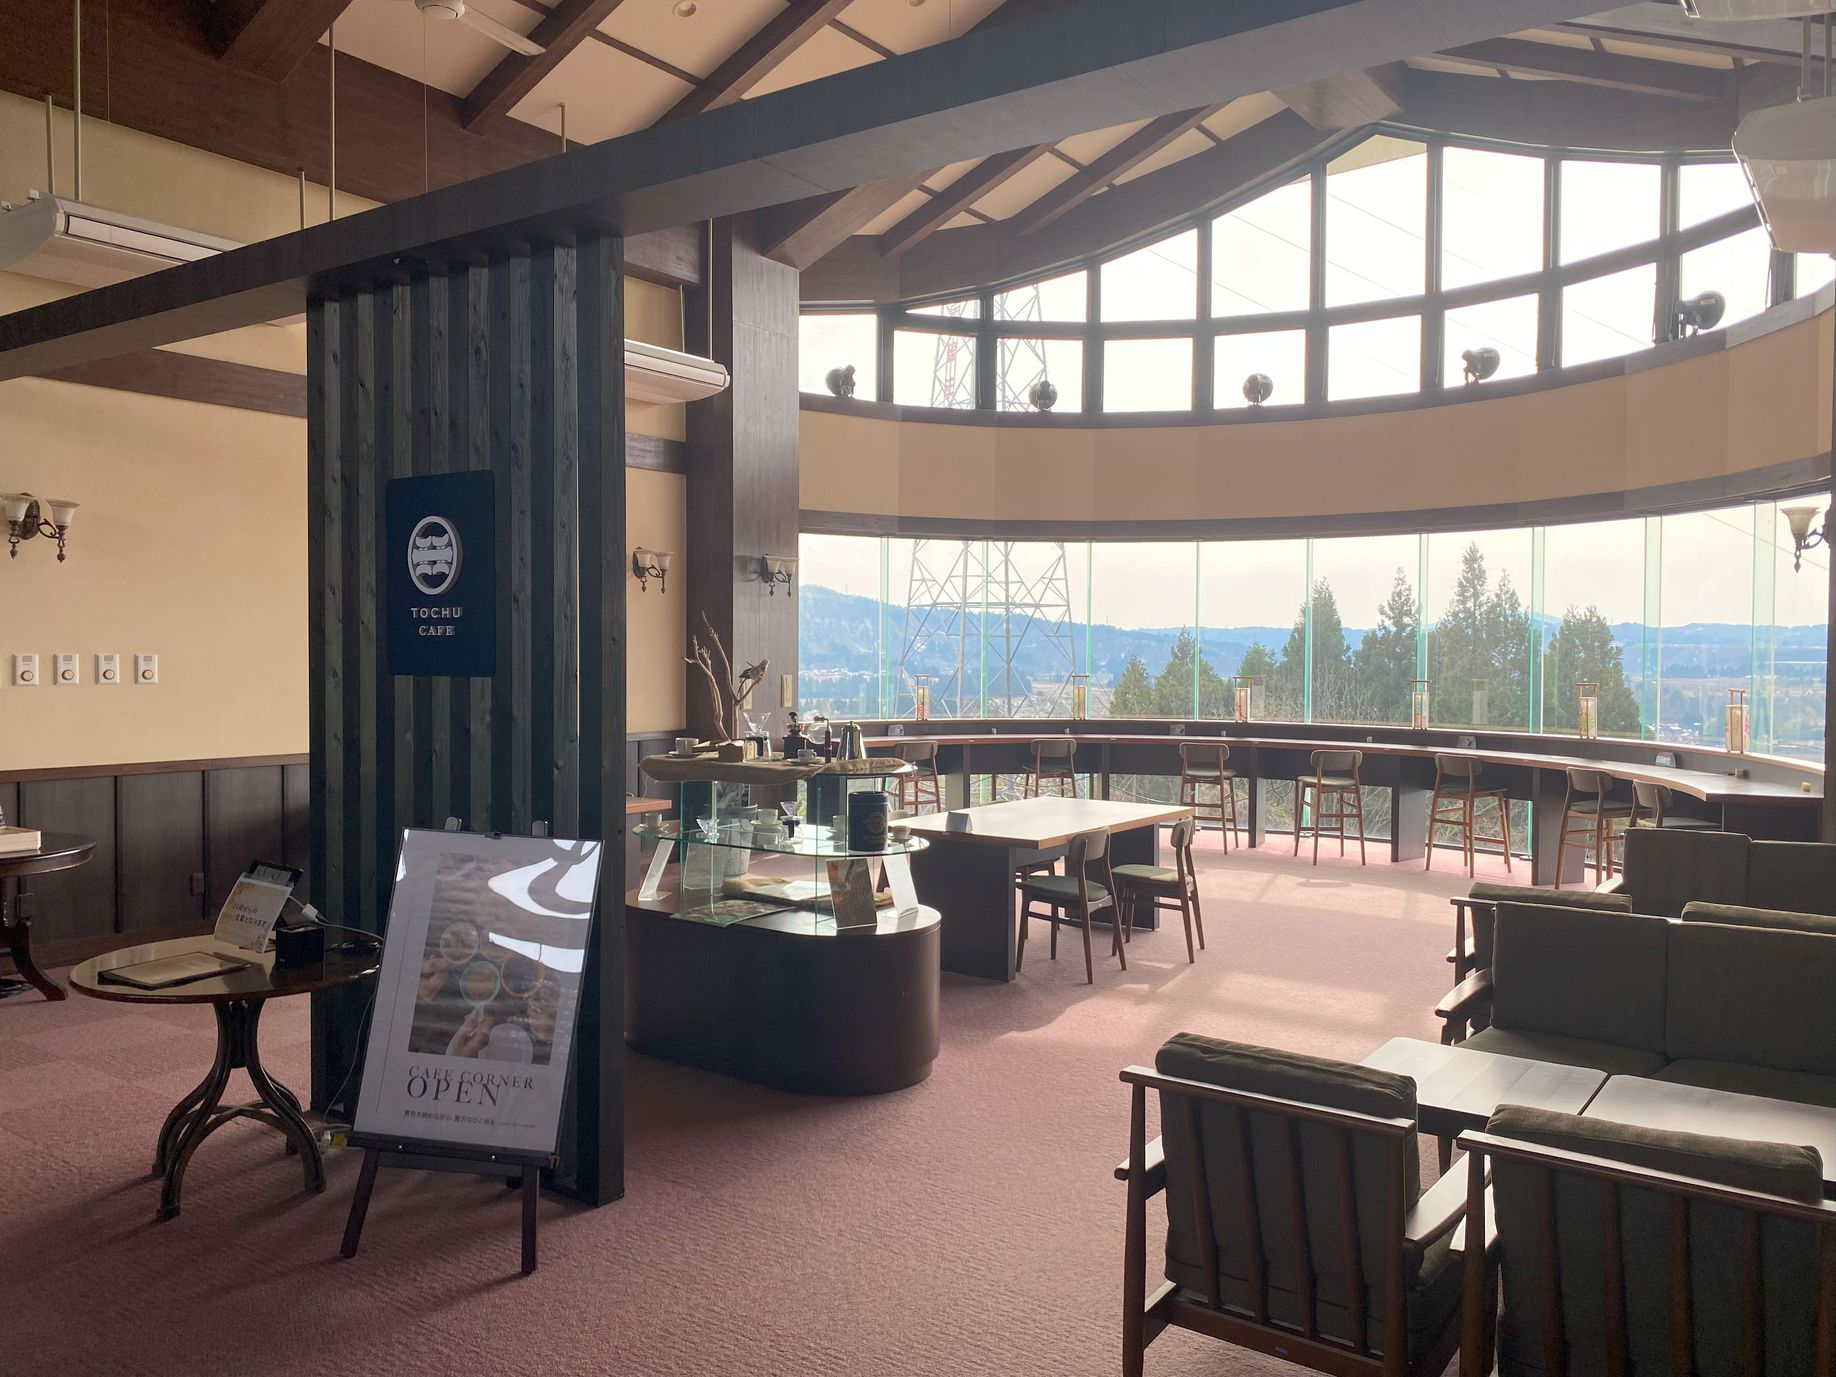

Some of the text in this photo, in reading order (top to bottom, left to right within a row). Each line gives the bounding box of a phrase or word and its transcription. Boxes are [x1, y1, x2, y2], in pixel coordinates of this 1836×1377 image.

[410, 607, 462, 619] TOCHU
[418, 625, 454, 636] CAFE
[409, 1065, 535, 1090] CAFE CORNER
[406, 1075, 501, 1107] OPEN
